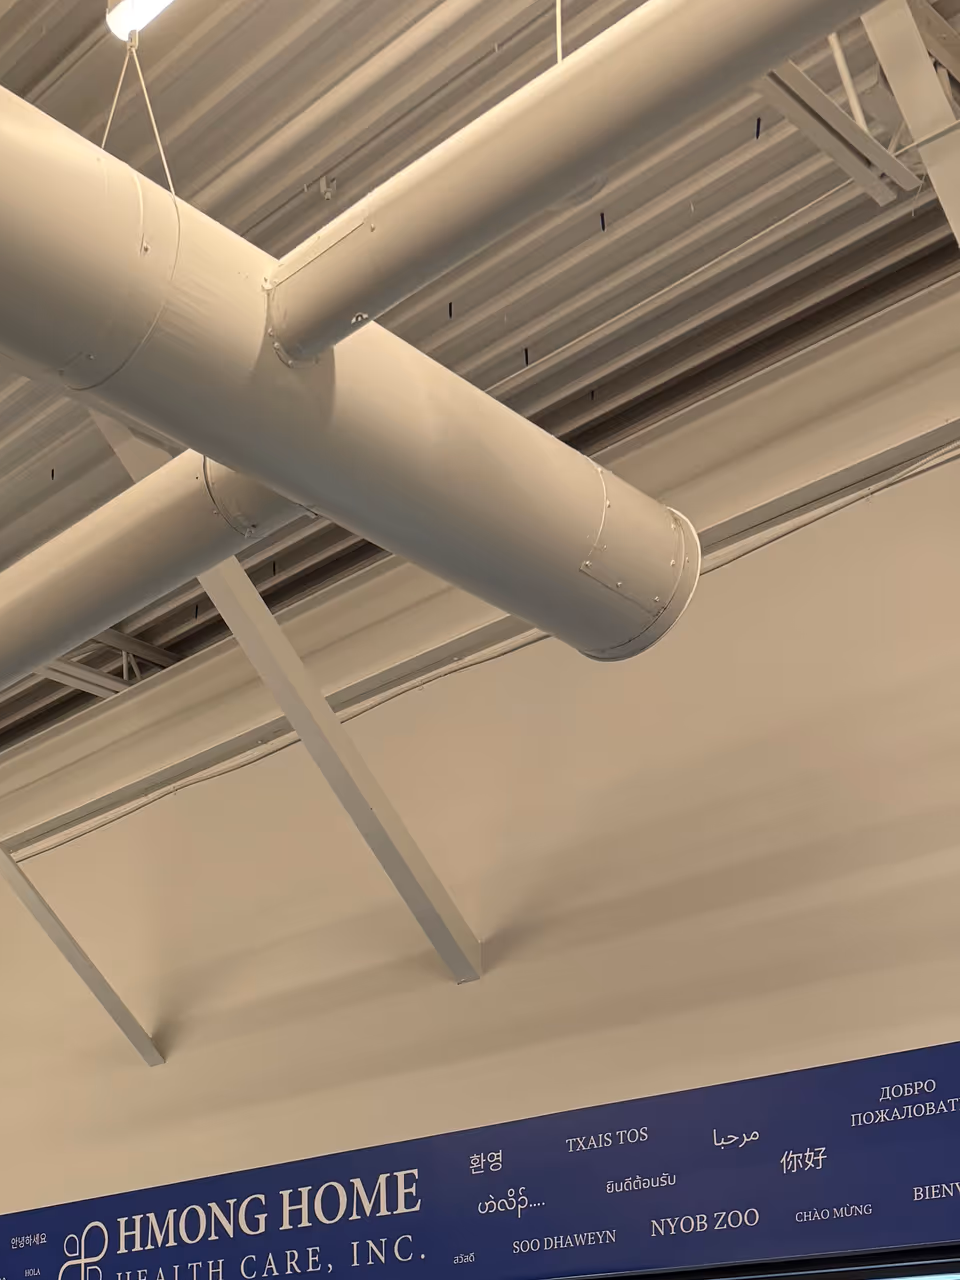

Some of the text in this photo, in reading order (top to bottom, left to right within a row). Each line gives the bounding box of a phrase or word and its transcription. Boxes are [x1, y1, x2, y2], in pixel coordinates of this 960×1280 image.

[879, 1079, 936, 1102] ДОБРО
[850, 1097, 960, 1127] ПОЖАЛОВАТ
[565, 1126, 648, 1153] TXAIS TOS
[712, 1128, 760, 1150] مرحبا
[469, 1150, 503, 1175] 환영
[780, 1147, 828, 1174] 你好
[606, 1172, 676, 1194] ยินดีต้อนรับ
[116, 1168, 421, 1255] HMONG HOME
[650, 1208, 760, 1237] NYOB ZOO
[795, 1207, 830, 1223] CHÀO
[10, 1232, 47, 1249] 안녕하세요
[512, 1230, 617, 1254] SOO DHAWEYN
[240, 1246, 334, 1280] CARE,
[351, 1234, 426, 1267] INC.
[24, 1268, 41, 1277] HOLA
